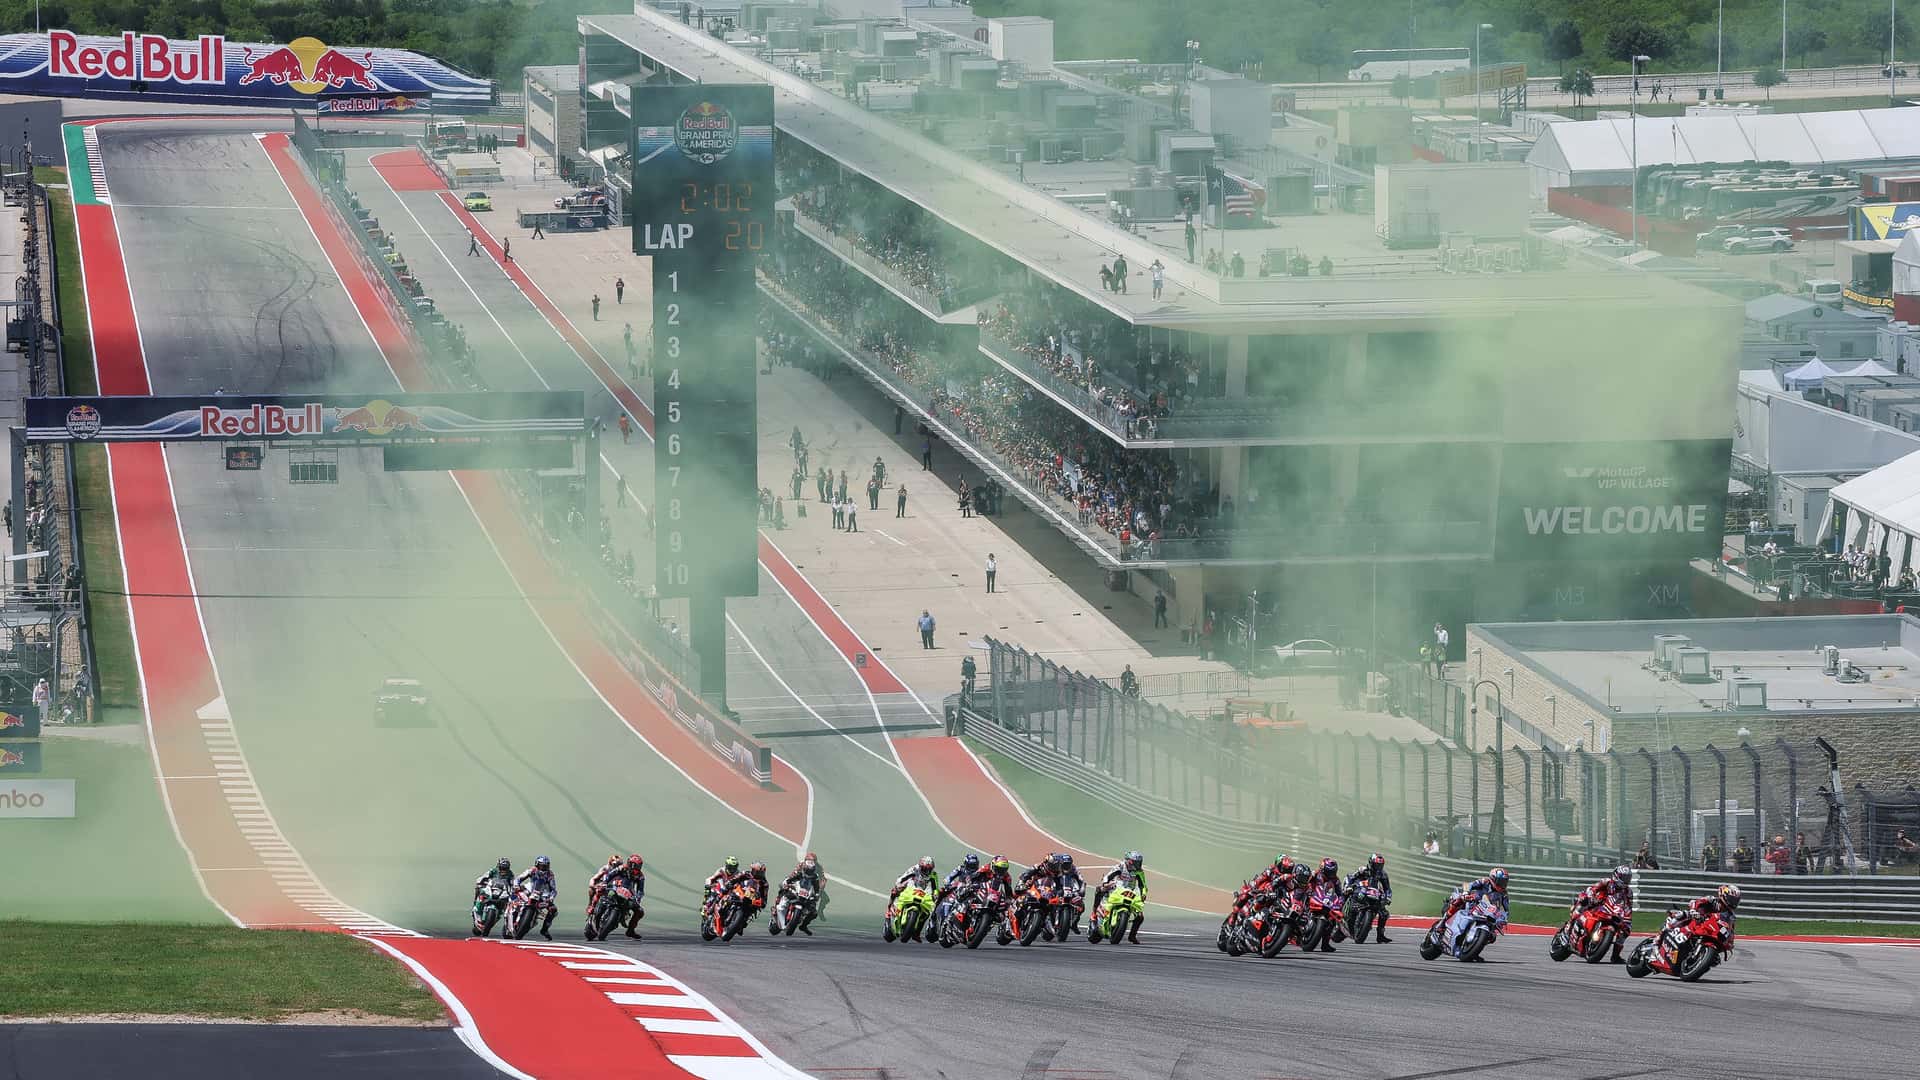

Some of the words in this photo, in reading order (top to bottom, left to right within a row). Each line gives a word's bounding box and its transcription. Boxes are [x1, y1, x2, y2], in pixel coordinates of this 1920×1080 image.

[49, 30, 135, 80] Red
[141, 34, 224, 83] Bull
[330, 100, 354, 112] Red
[356, 98, 379, 111] Bull
[680, 130, 711, 140] GRAND
[681, 183, 752, 212] 2:02
[644, 223, 694, 250] LAP
[725, 221, 764, 250] 20
[668, 271, 679, 293] 1
[667, 303, 680, 325] 2
[667, 336, 680, 358] 3
[667, 368, 681, 390] 4
[201, 404, 261, 436] Red
[264, 403, 323, 435] Bull
[668, 401, 681, 423] 5
[668, 433, 681, 455] 6
[668, 466, 681, 487] 7
[1598, 479, 1617, 489] VIP
[1620, 478, 1671, 489] VILLAGE
[669, 499, 681, 520] 8
[1523, 504, 1708, 535] WELCOME
[669, 531, 682, 552] 9
[664, 563, 689, 585] 10
[1647, 584, 1680, 603] XM
